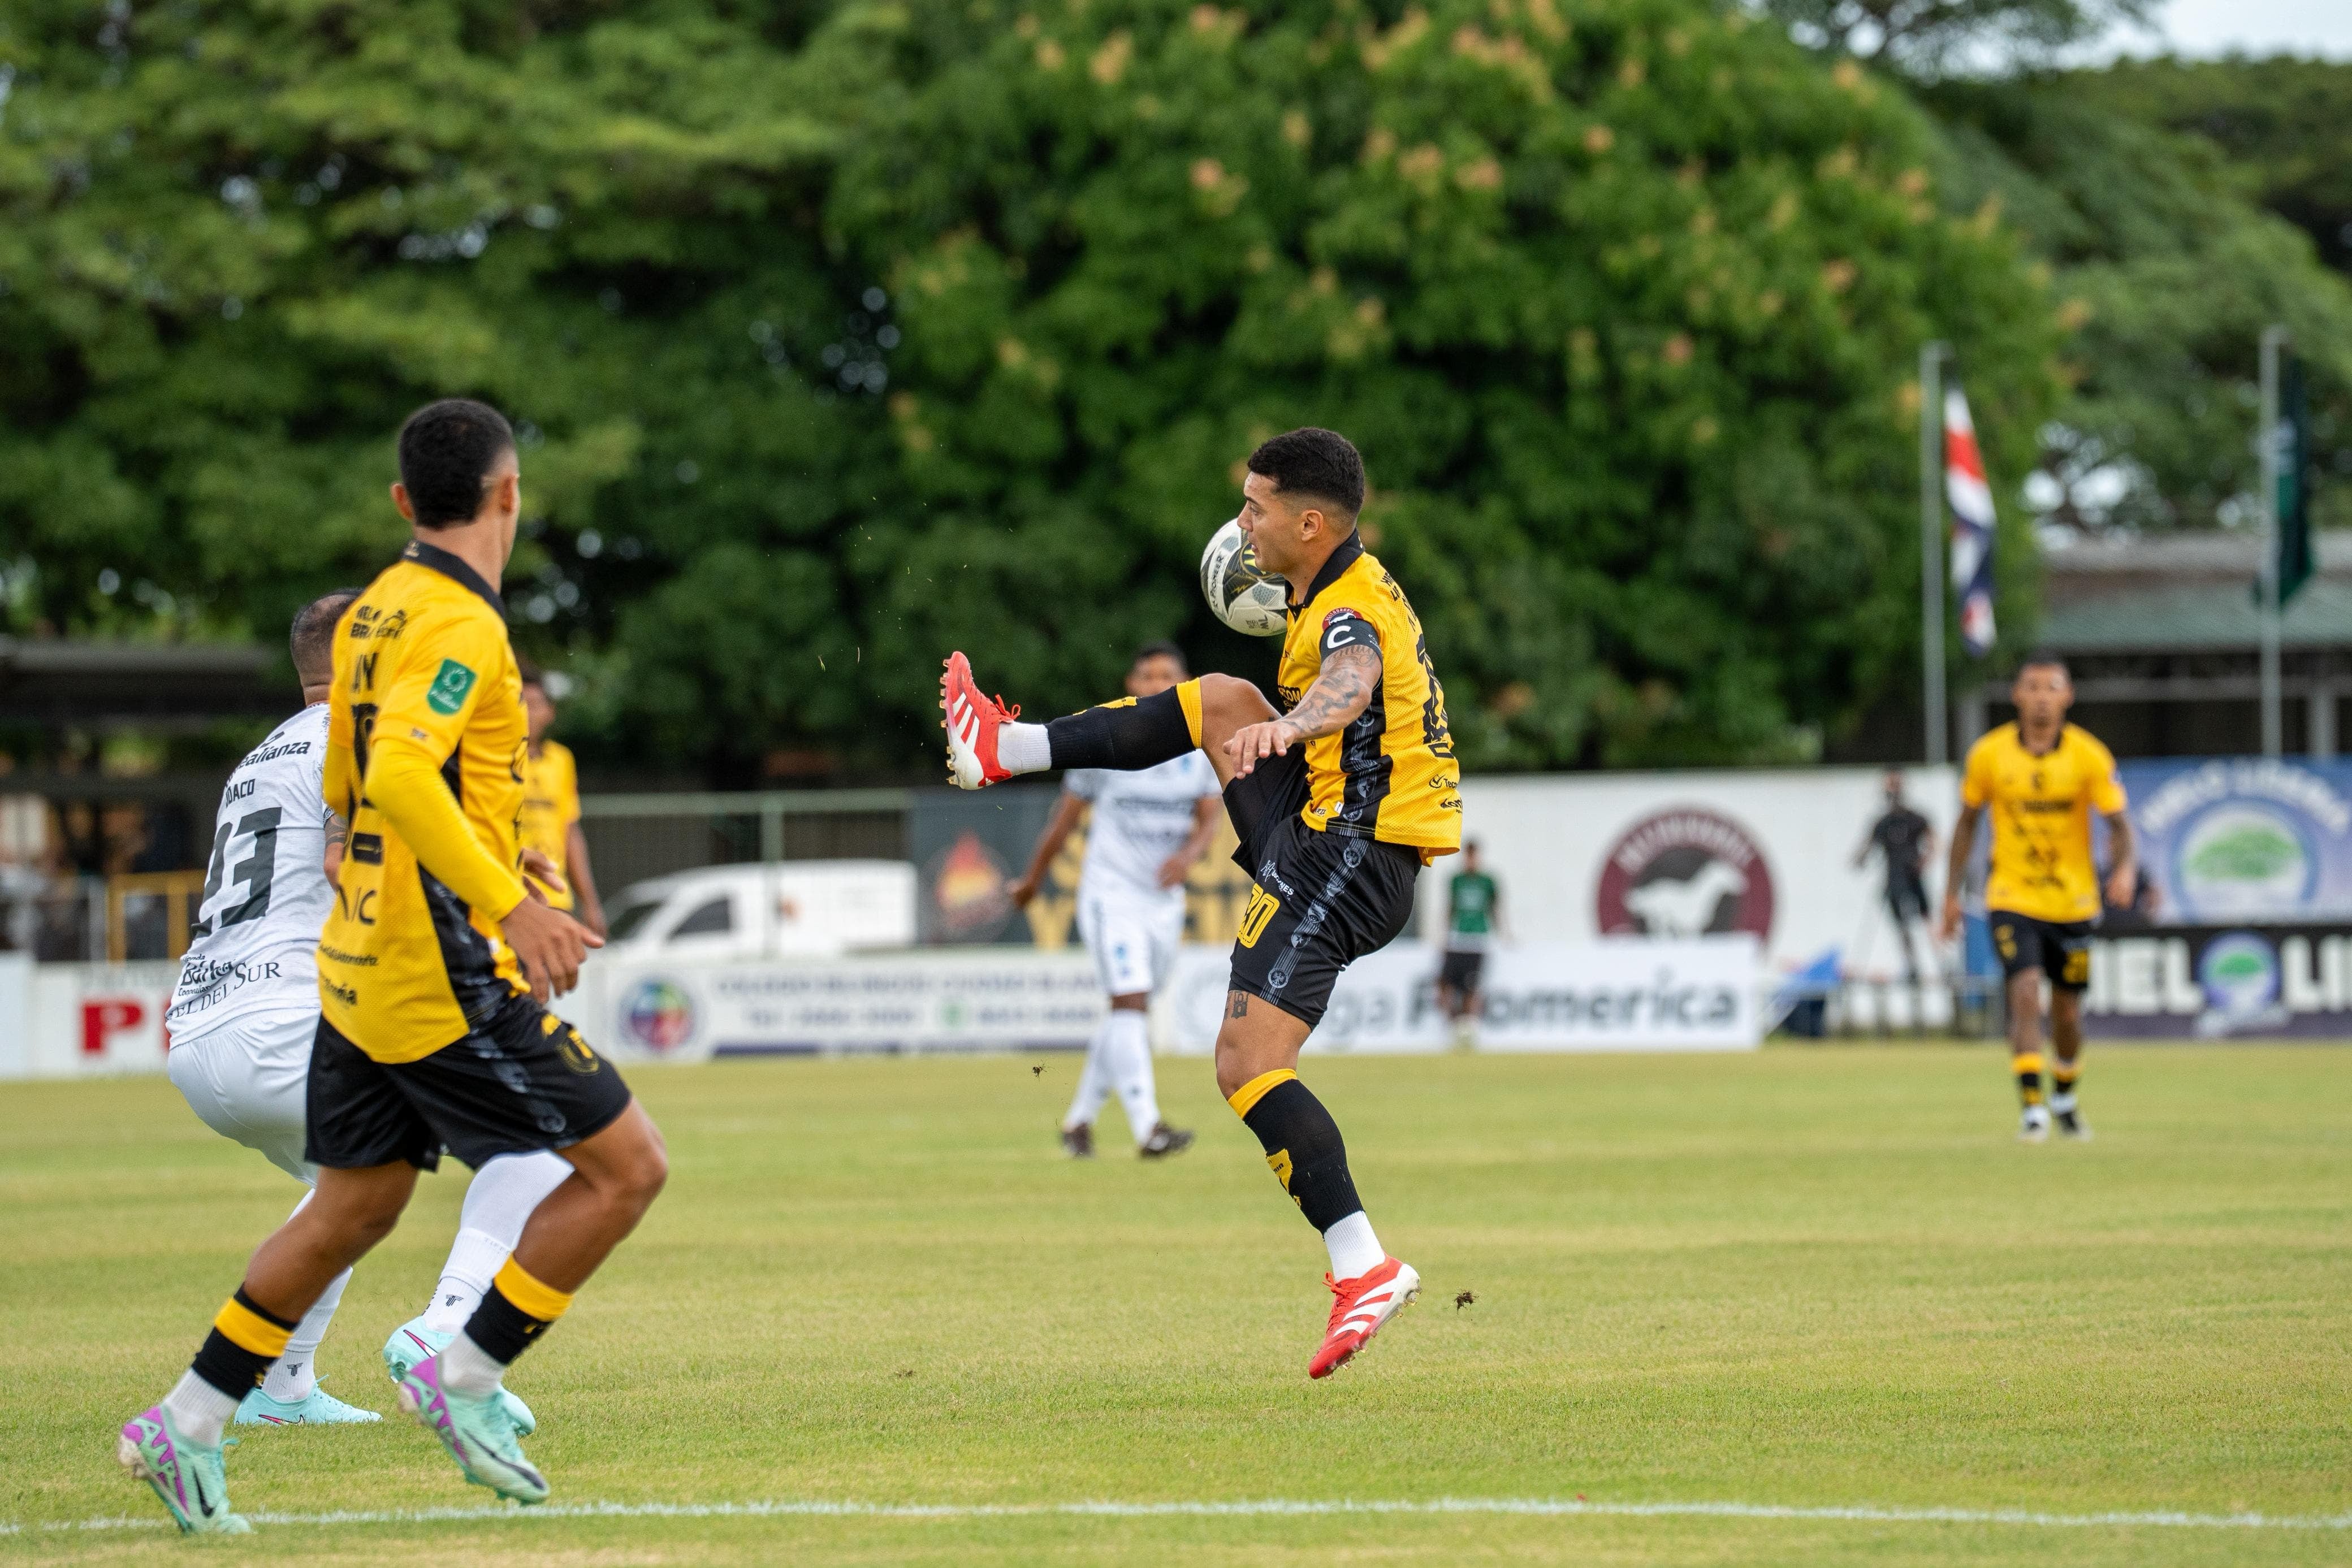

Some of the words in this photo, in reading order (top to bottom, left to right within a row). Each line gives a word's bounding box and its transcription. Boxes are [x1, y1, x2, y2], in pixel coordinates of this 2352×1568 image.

[1326, 625, 1356, 649] C
[191, 807, 282, 941] 23
[234, 961, 283, 990] SUR
[1407, 964, 1737, 1031] Pomerica
[2085, 936, 2203, 1015] IEL
